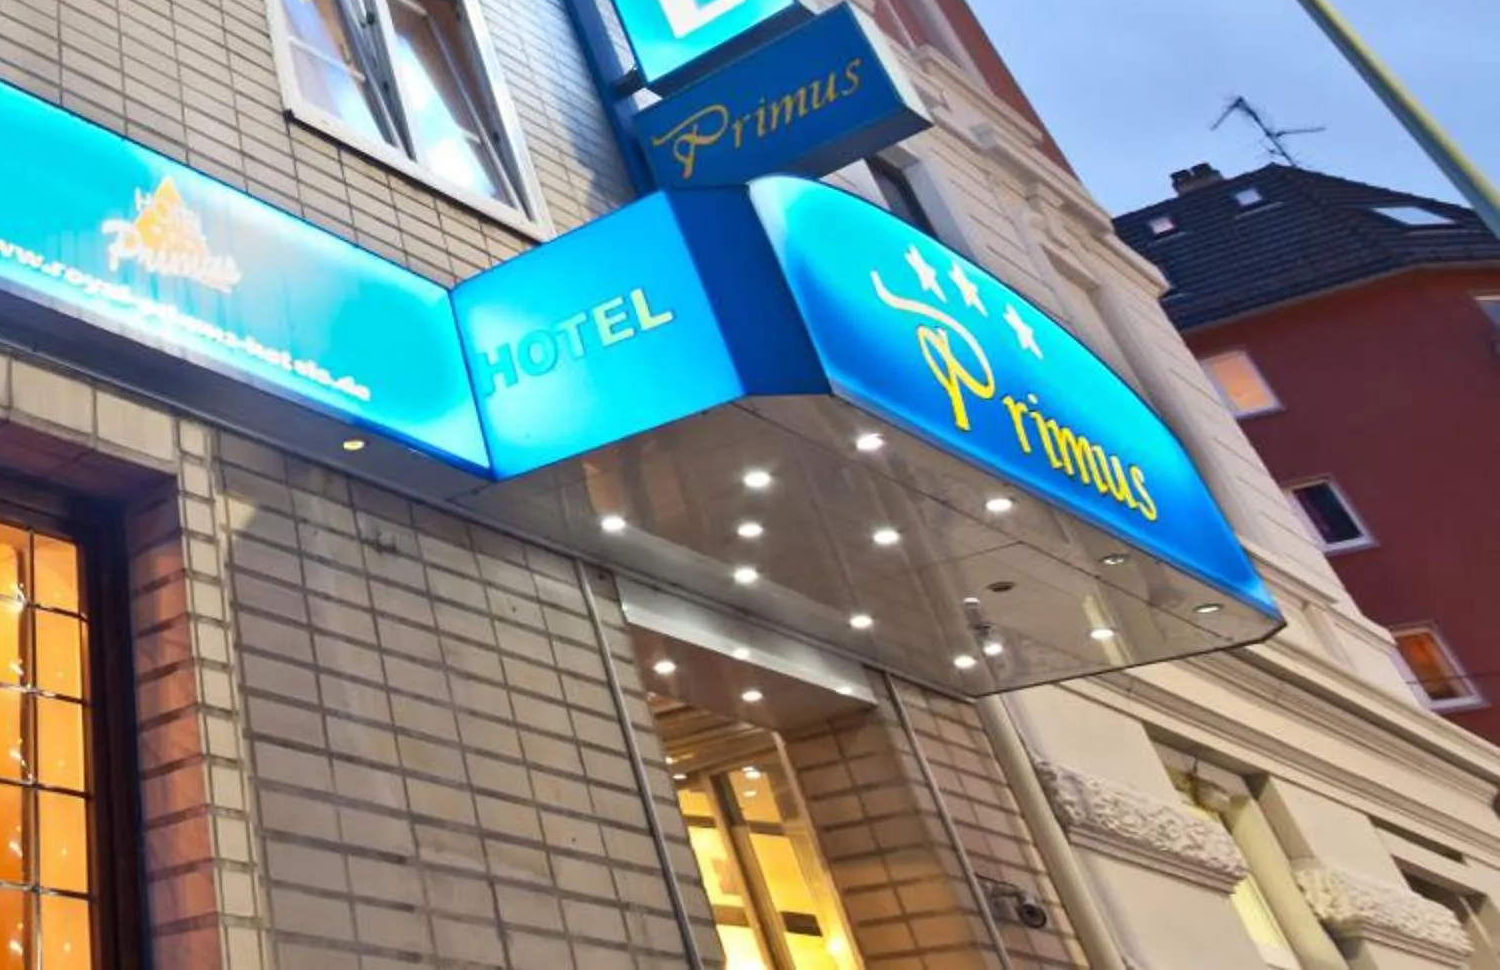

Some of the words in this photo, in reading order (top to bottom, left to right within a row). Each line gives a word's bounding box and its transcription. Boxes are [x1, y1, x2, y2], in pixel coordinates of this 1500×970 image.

[652, 57, 862, 179] Primus
[479, 287, 676, 398] HOTEL
[870, 270, 1158, 521] Primus
